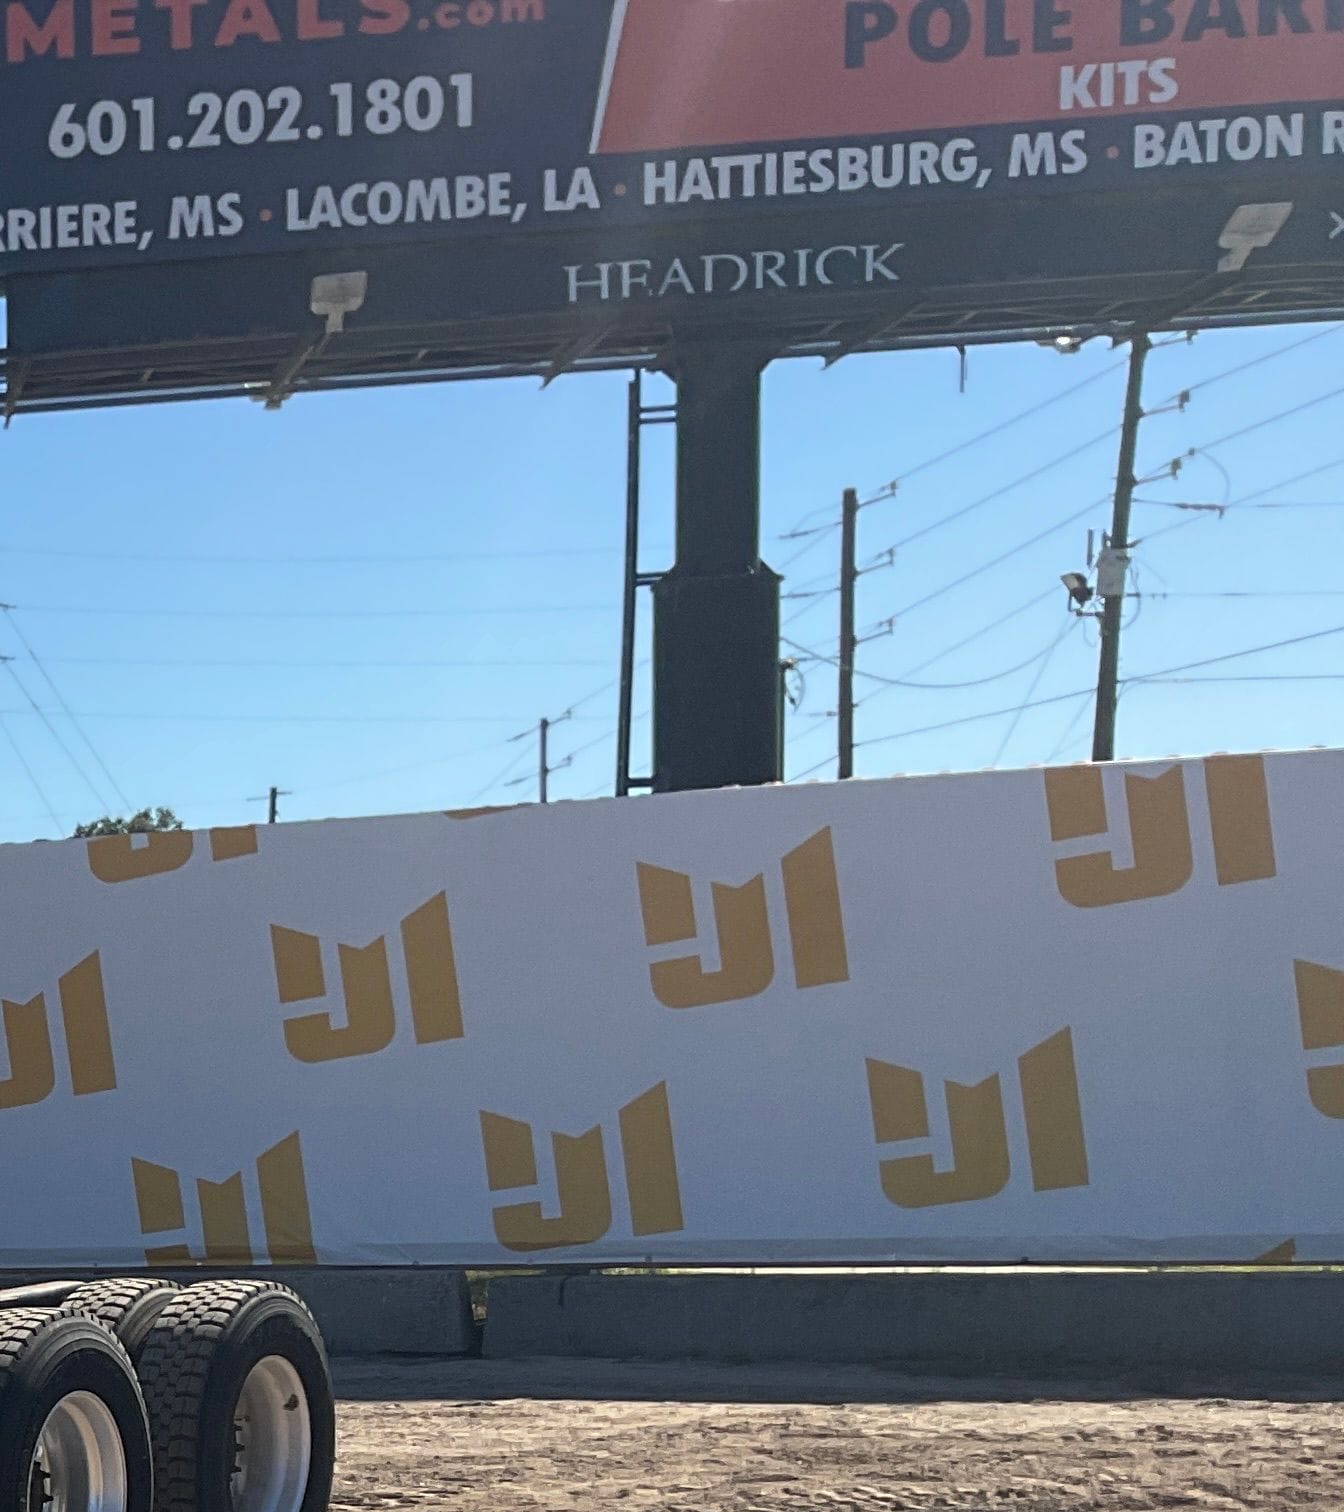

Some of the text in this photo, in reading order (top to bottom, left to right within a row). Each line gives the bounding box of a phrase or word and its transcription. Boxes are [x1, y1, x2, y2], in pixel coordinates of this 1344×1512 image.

[843, 0, 1344, 70] POLE BAR
[48, 73, 473, 158] 601.202.1801
[1060, 58, 1179, 110] KITS
[168, 193, 243, 239] MS
[286, 172, 527, 231] LACOMBE,
[543, 166, 601, 212] LA
[643, 139, 992, 206] HATTIESBURG,
[1008, 129, 1088, 178] MS
[1134, 114, 1304, 169] BATON
[562, 243, 906, 302] HEADRICK
